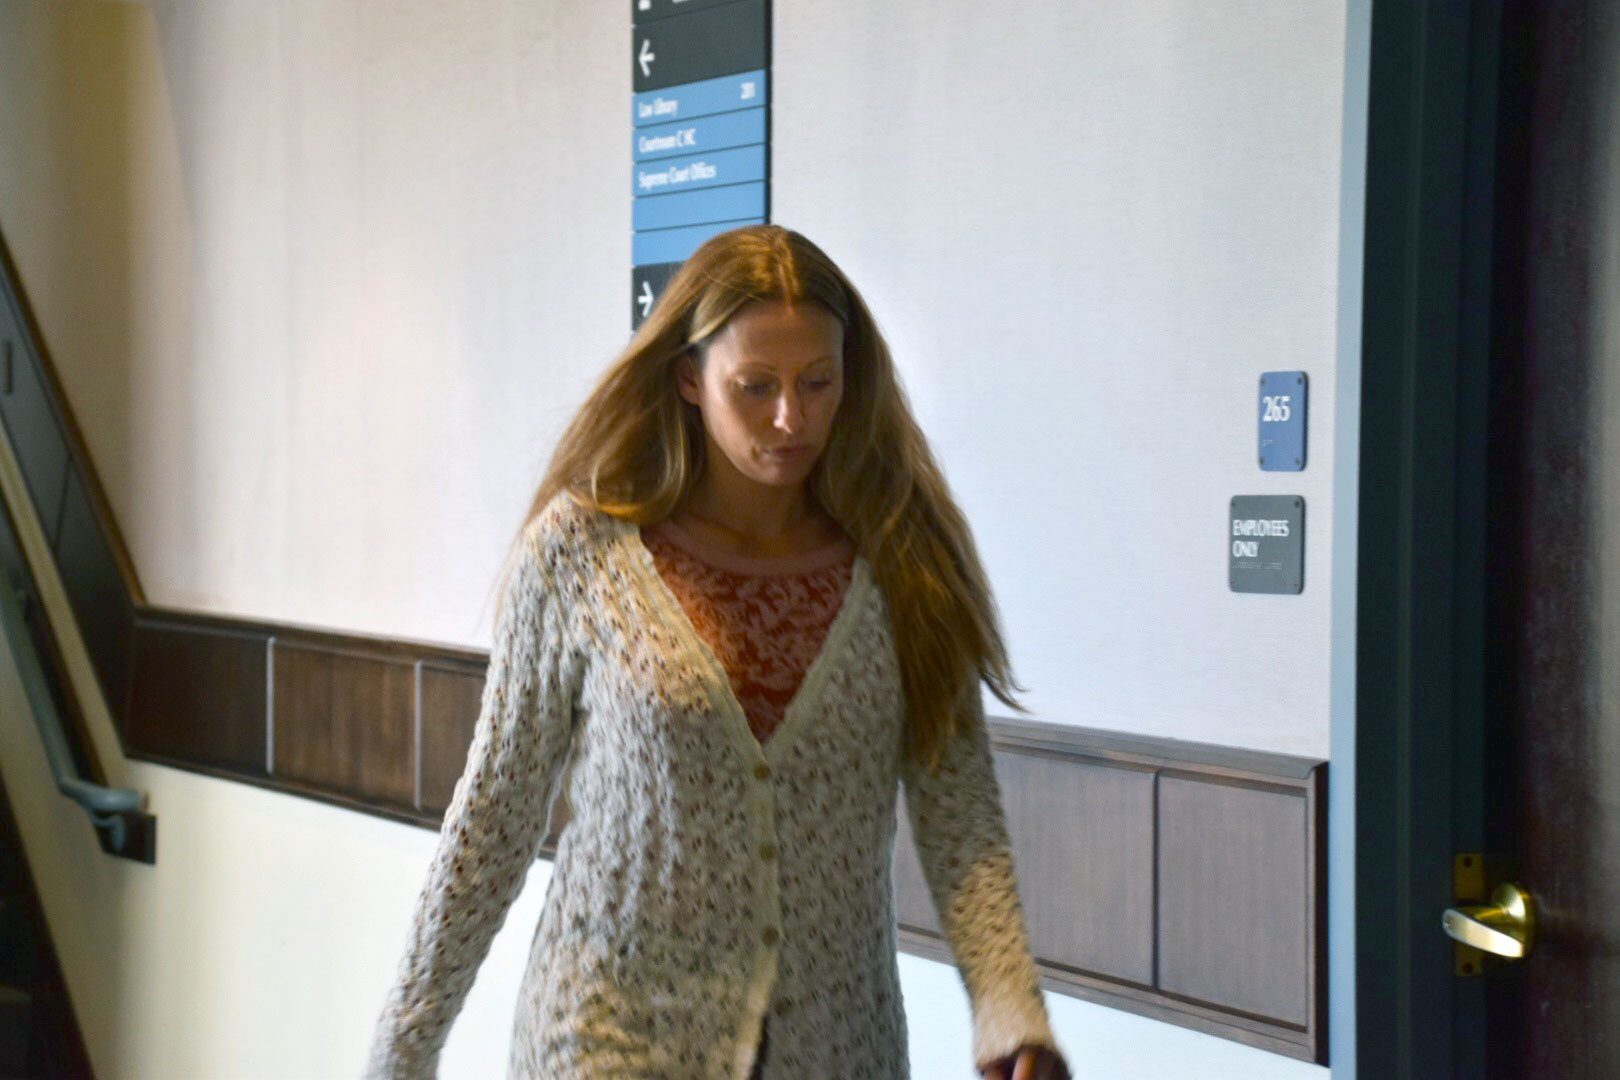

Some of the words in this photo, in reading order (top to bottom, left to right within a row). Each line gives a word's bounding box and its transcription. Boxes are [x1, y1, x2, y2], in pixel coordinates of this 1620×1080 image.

[638, 171, 669, 191] Supreme
[669, 166, 690, 184] Court
[1262, 395, 1291, 422] 265
[1232, 519, 1290, 537] EMPLOYEES
[1232, 540, 1261, 557] ONLY
